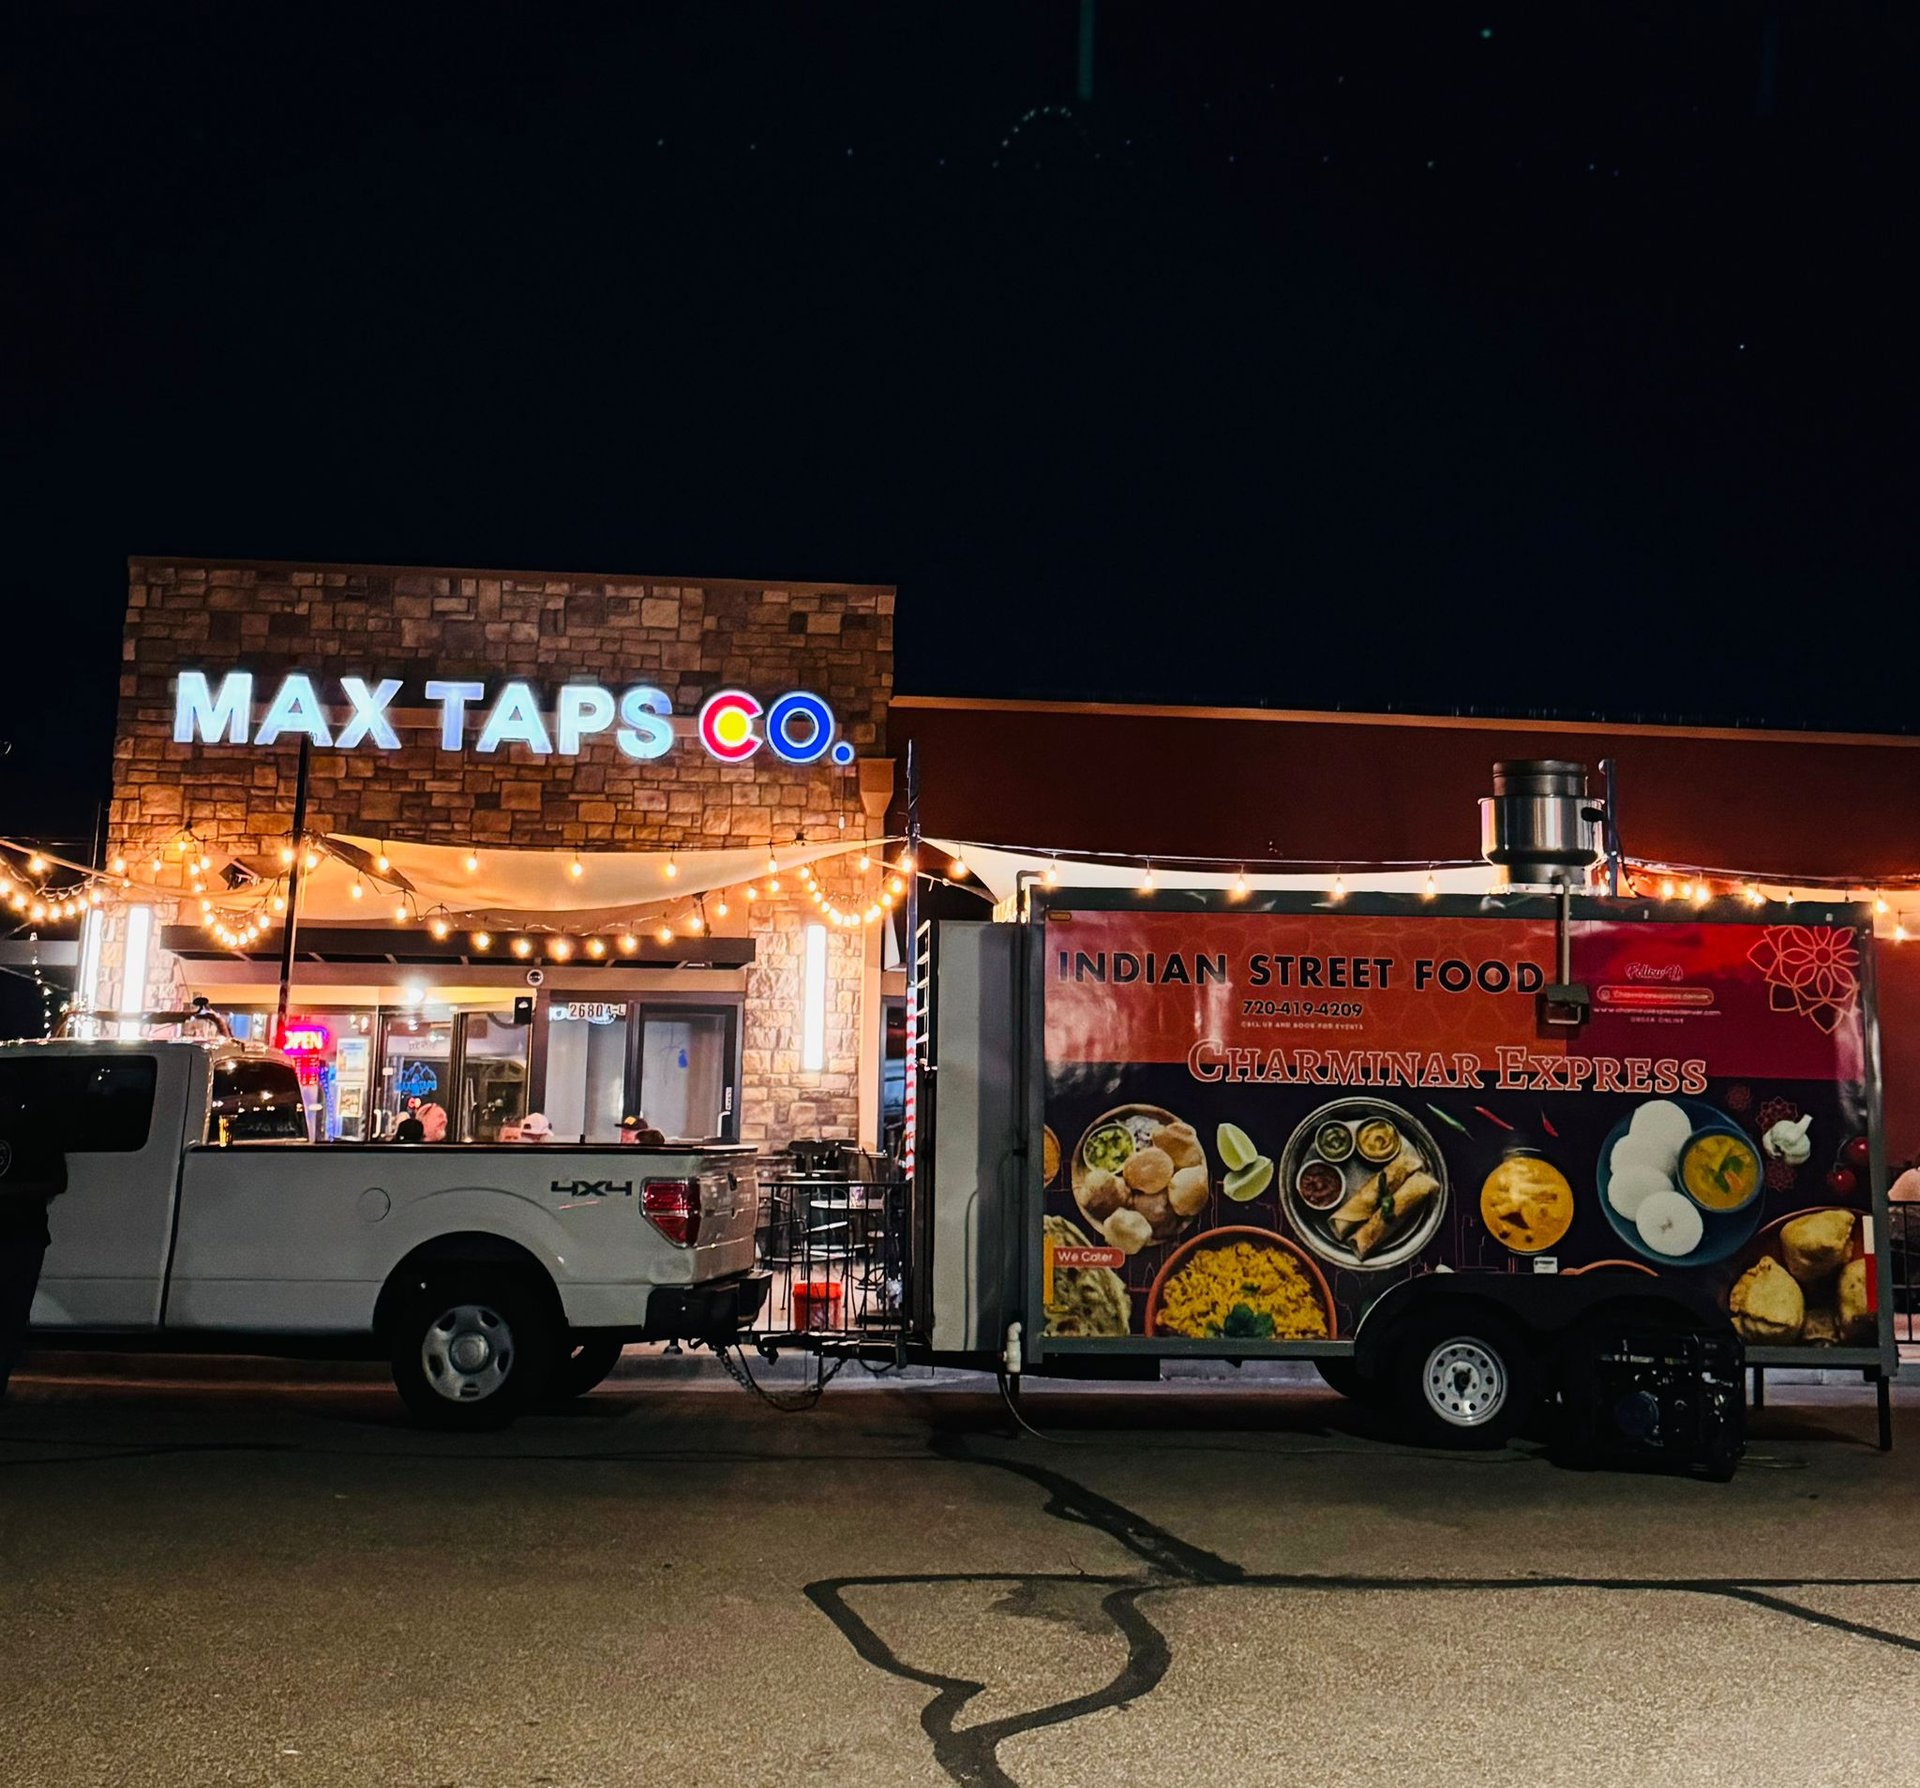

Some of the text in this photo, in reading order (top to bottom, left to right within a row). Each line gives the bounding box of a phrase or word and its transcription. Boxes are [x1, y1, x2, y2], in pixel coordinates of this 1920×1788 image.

[173, 671, 856, 765] MAX TAPS CO.
[1058, 951, 1545, 994] INDIAN STREET FOOD
[569, 1003, 604, 1018] 2680
[1242, 1000, 1363, 1017] 720-419-4209
[1275, 1021, 1291, 1029] AND
[282, 1030, 324, 1050] OPEN
[1187, 1039, 1708, 1095] CHARMINAR EXPRESS
[1057, 1251, 1113, 1263] We Cater
